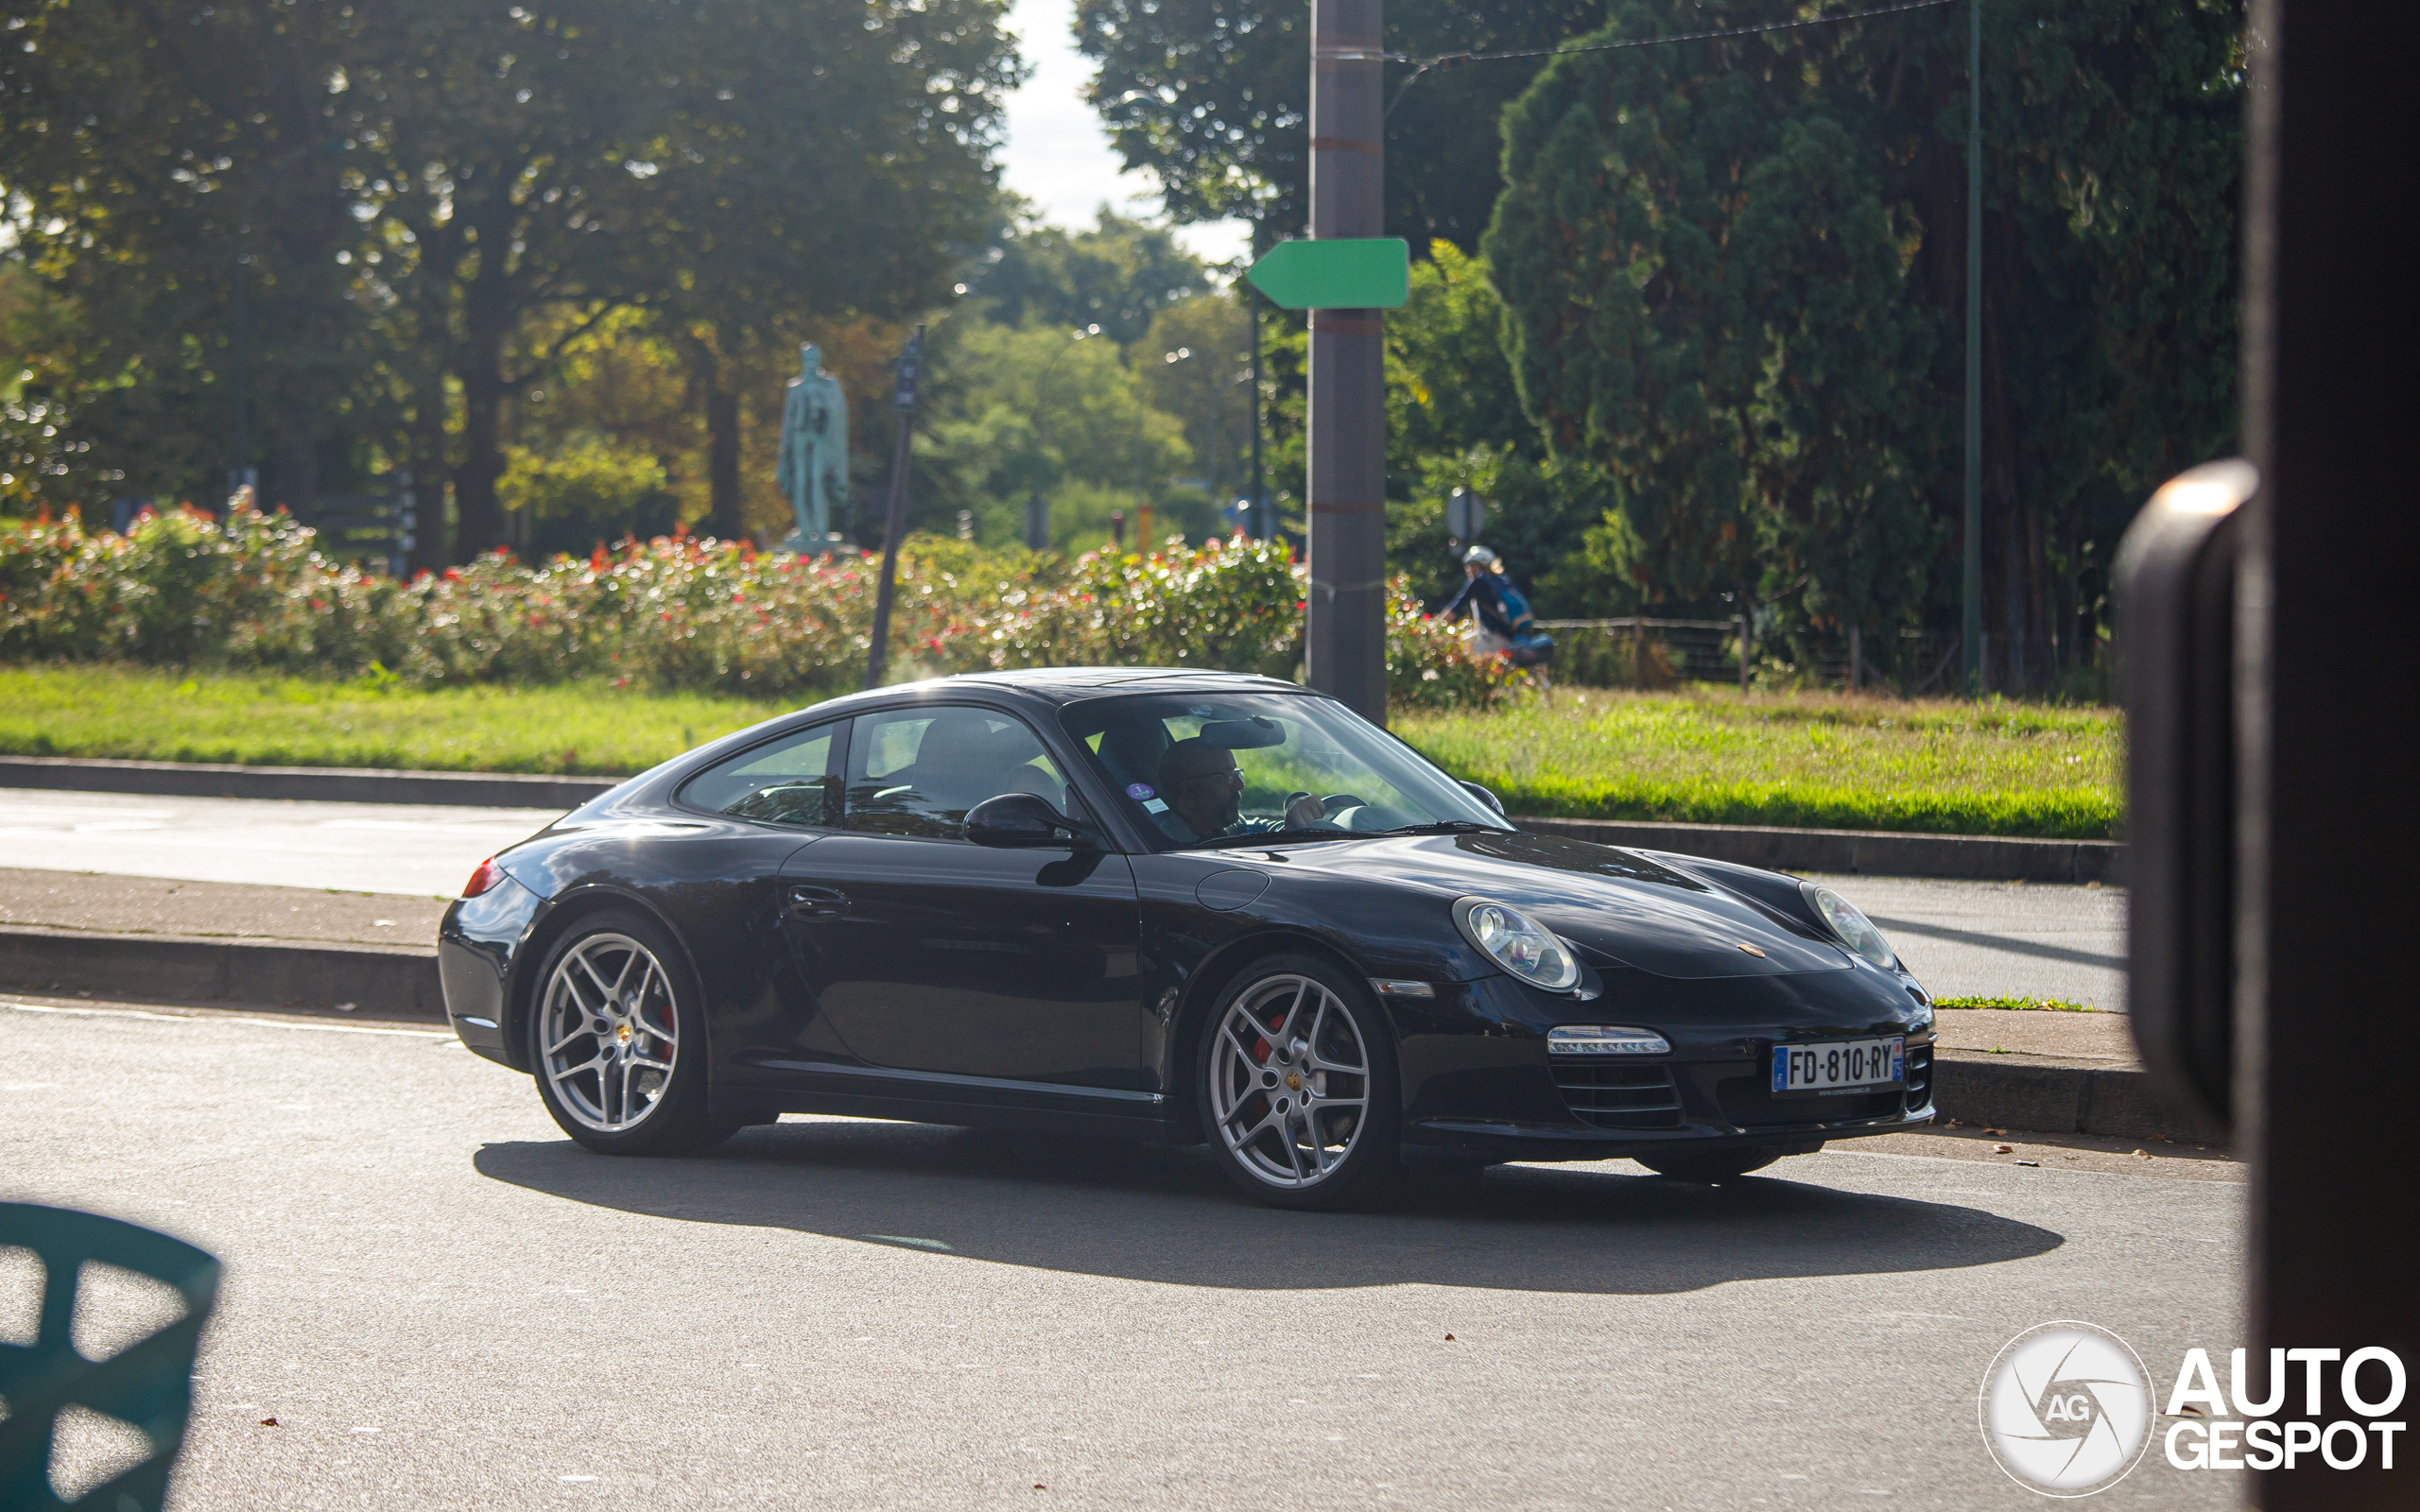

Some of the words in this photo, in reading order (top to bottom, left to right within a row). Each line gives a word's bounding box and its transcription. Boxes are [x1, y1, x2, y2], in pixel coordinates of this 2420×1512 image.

[1789, 1043, 1892, 1085] FD-810-RY
[1893, 1061, 1902, 1076] 75
[1777, 1073, 1783, 1083] F
